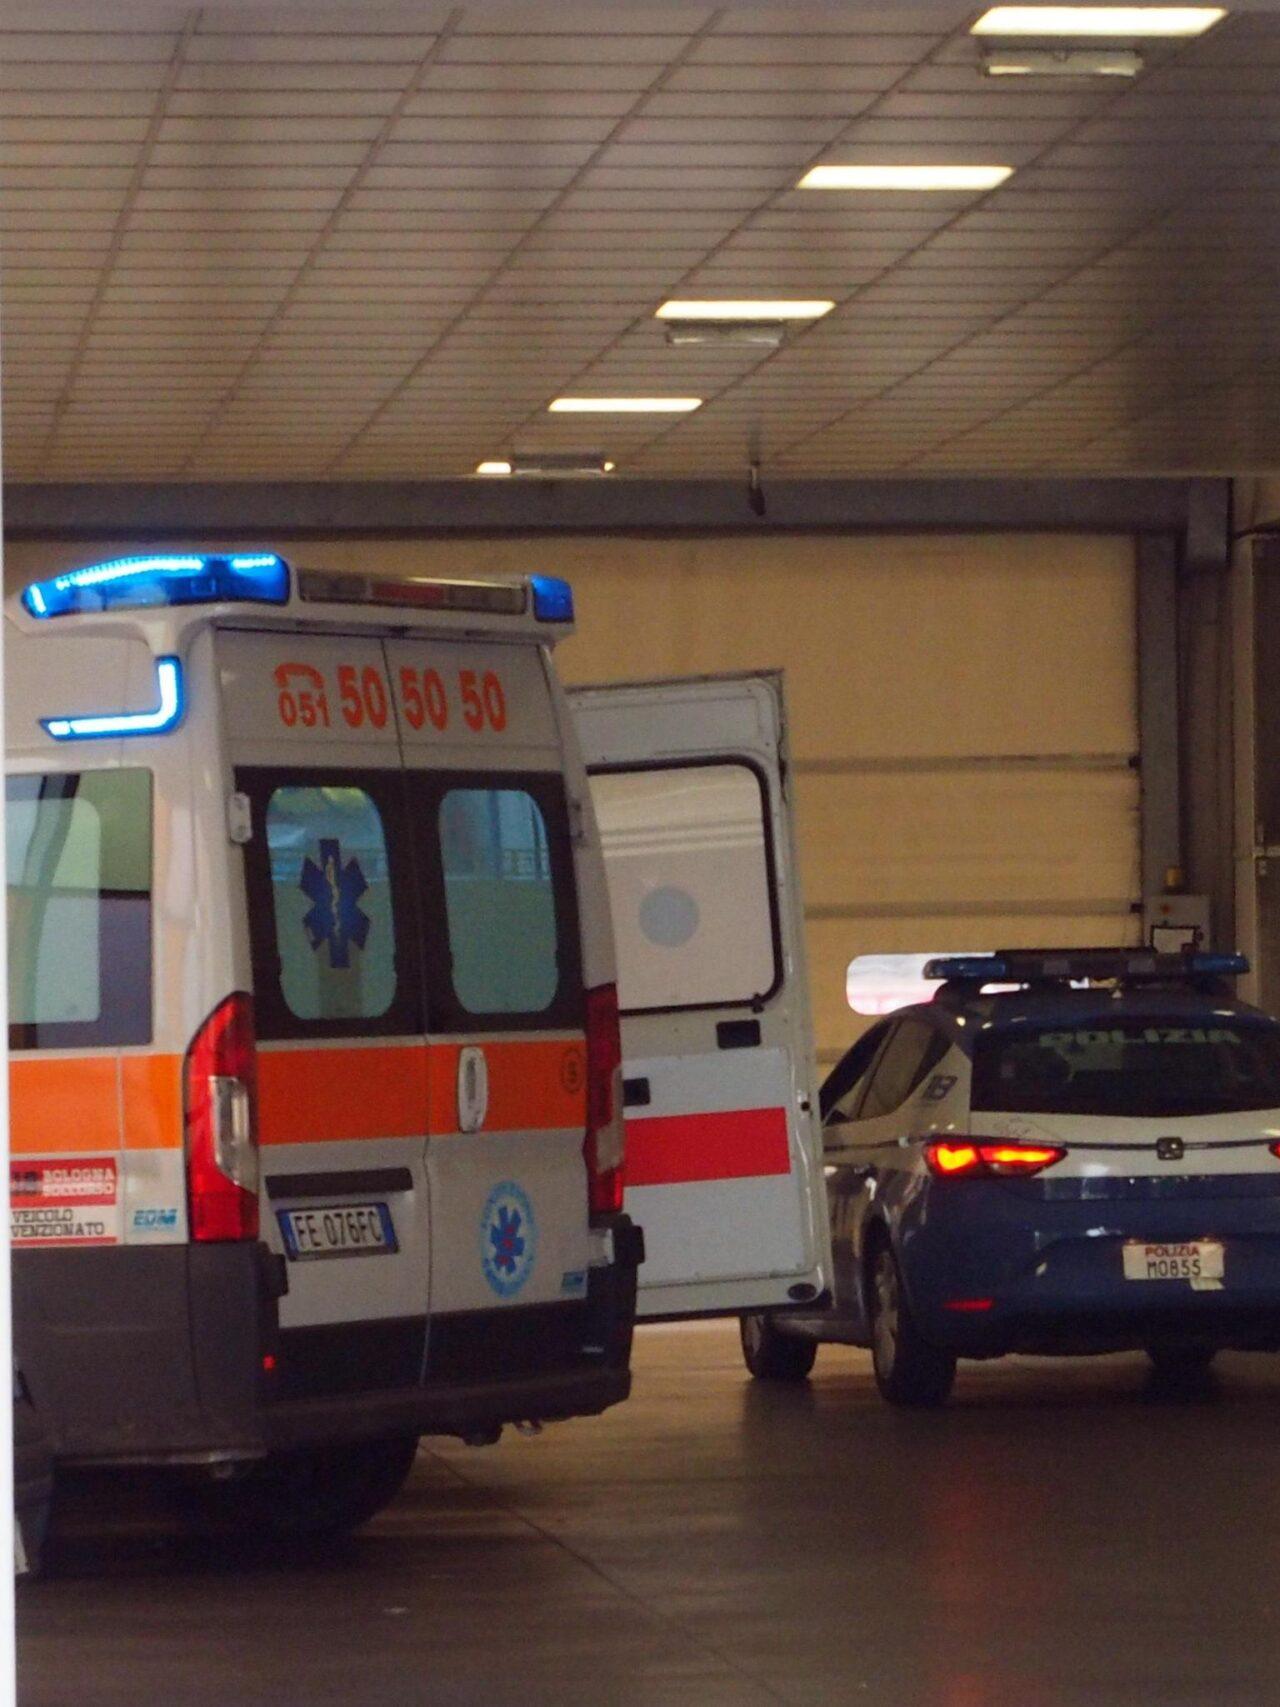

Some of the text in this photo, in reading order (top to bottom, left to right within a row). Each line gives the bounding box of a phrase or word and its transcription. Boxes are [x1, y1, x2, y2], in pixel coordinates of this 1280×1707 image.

[278, 665, 506, 732] 051 50 50 50
[1039, 1029, 1241, 1048] POLIZIA
[12, 1209, 73, 1223] VEICOLO
[294, 1214, 321, 1248] FE
[1145, 1245, 1200, 1258] POLIZIA
